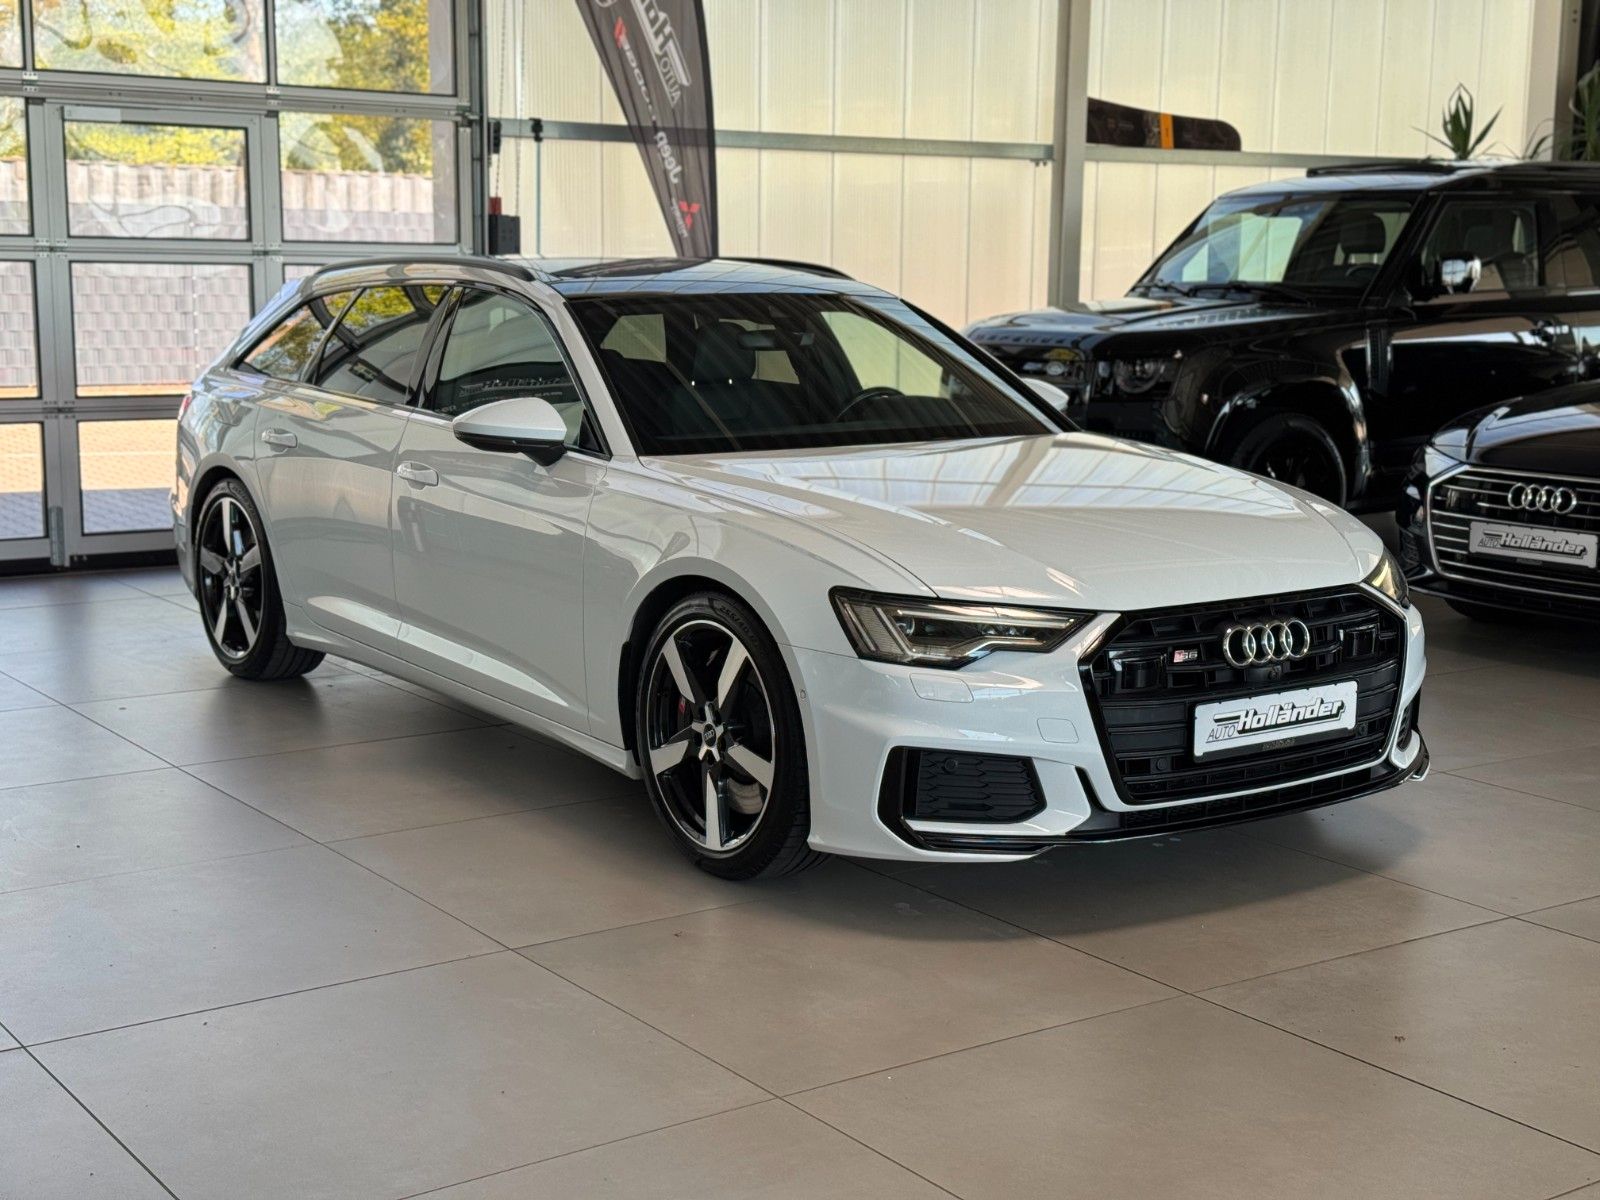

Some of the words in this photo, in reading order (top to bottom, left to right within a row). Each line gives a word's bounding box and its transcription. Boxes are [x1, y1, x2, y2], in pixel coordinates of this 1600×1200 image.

[1496, 531, 1588, 557] Holländer
[1207, 724, 1236, 742] AUTO
[1232, 697, 1346, 735] Holländer
